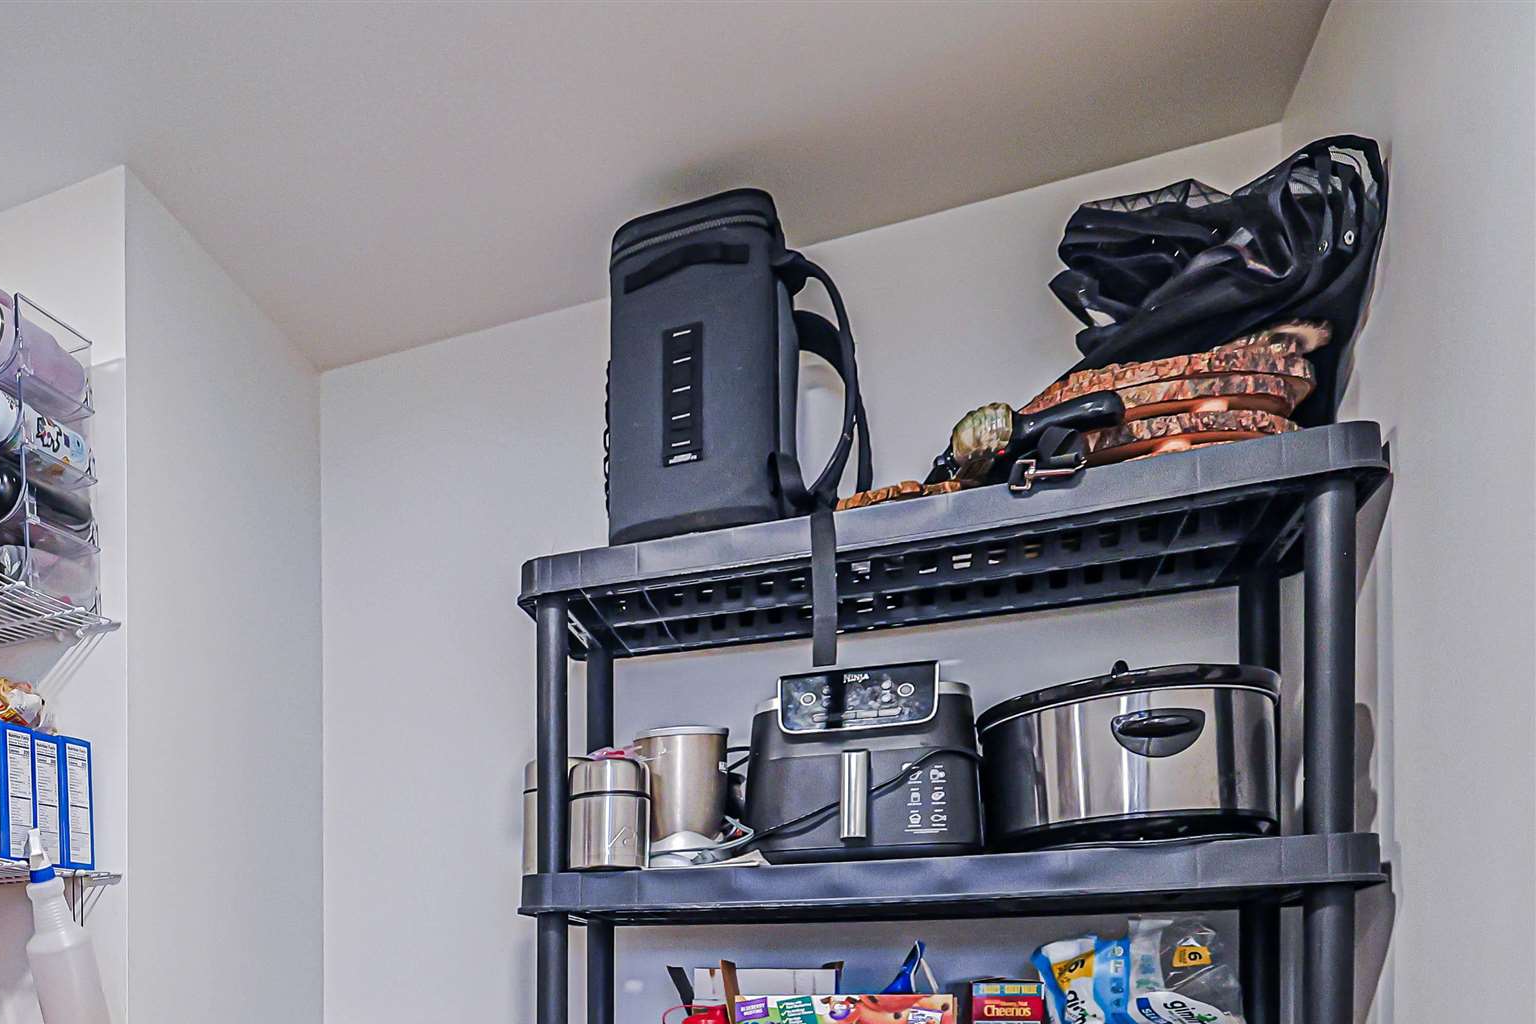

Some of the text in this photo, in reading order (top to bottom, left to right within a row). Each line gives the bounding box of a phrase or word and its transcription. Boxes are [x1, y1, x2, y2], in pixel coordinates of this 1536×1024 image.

[843, 673, 870, 684] NINJA
[741, 1003, 765, 1012] BLUEBERRY
[983, 1005, 1032, 1018] Cheerios
